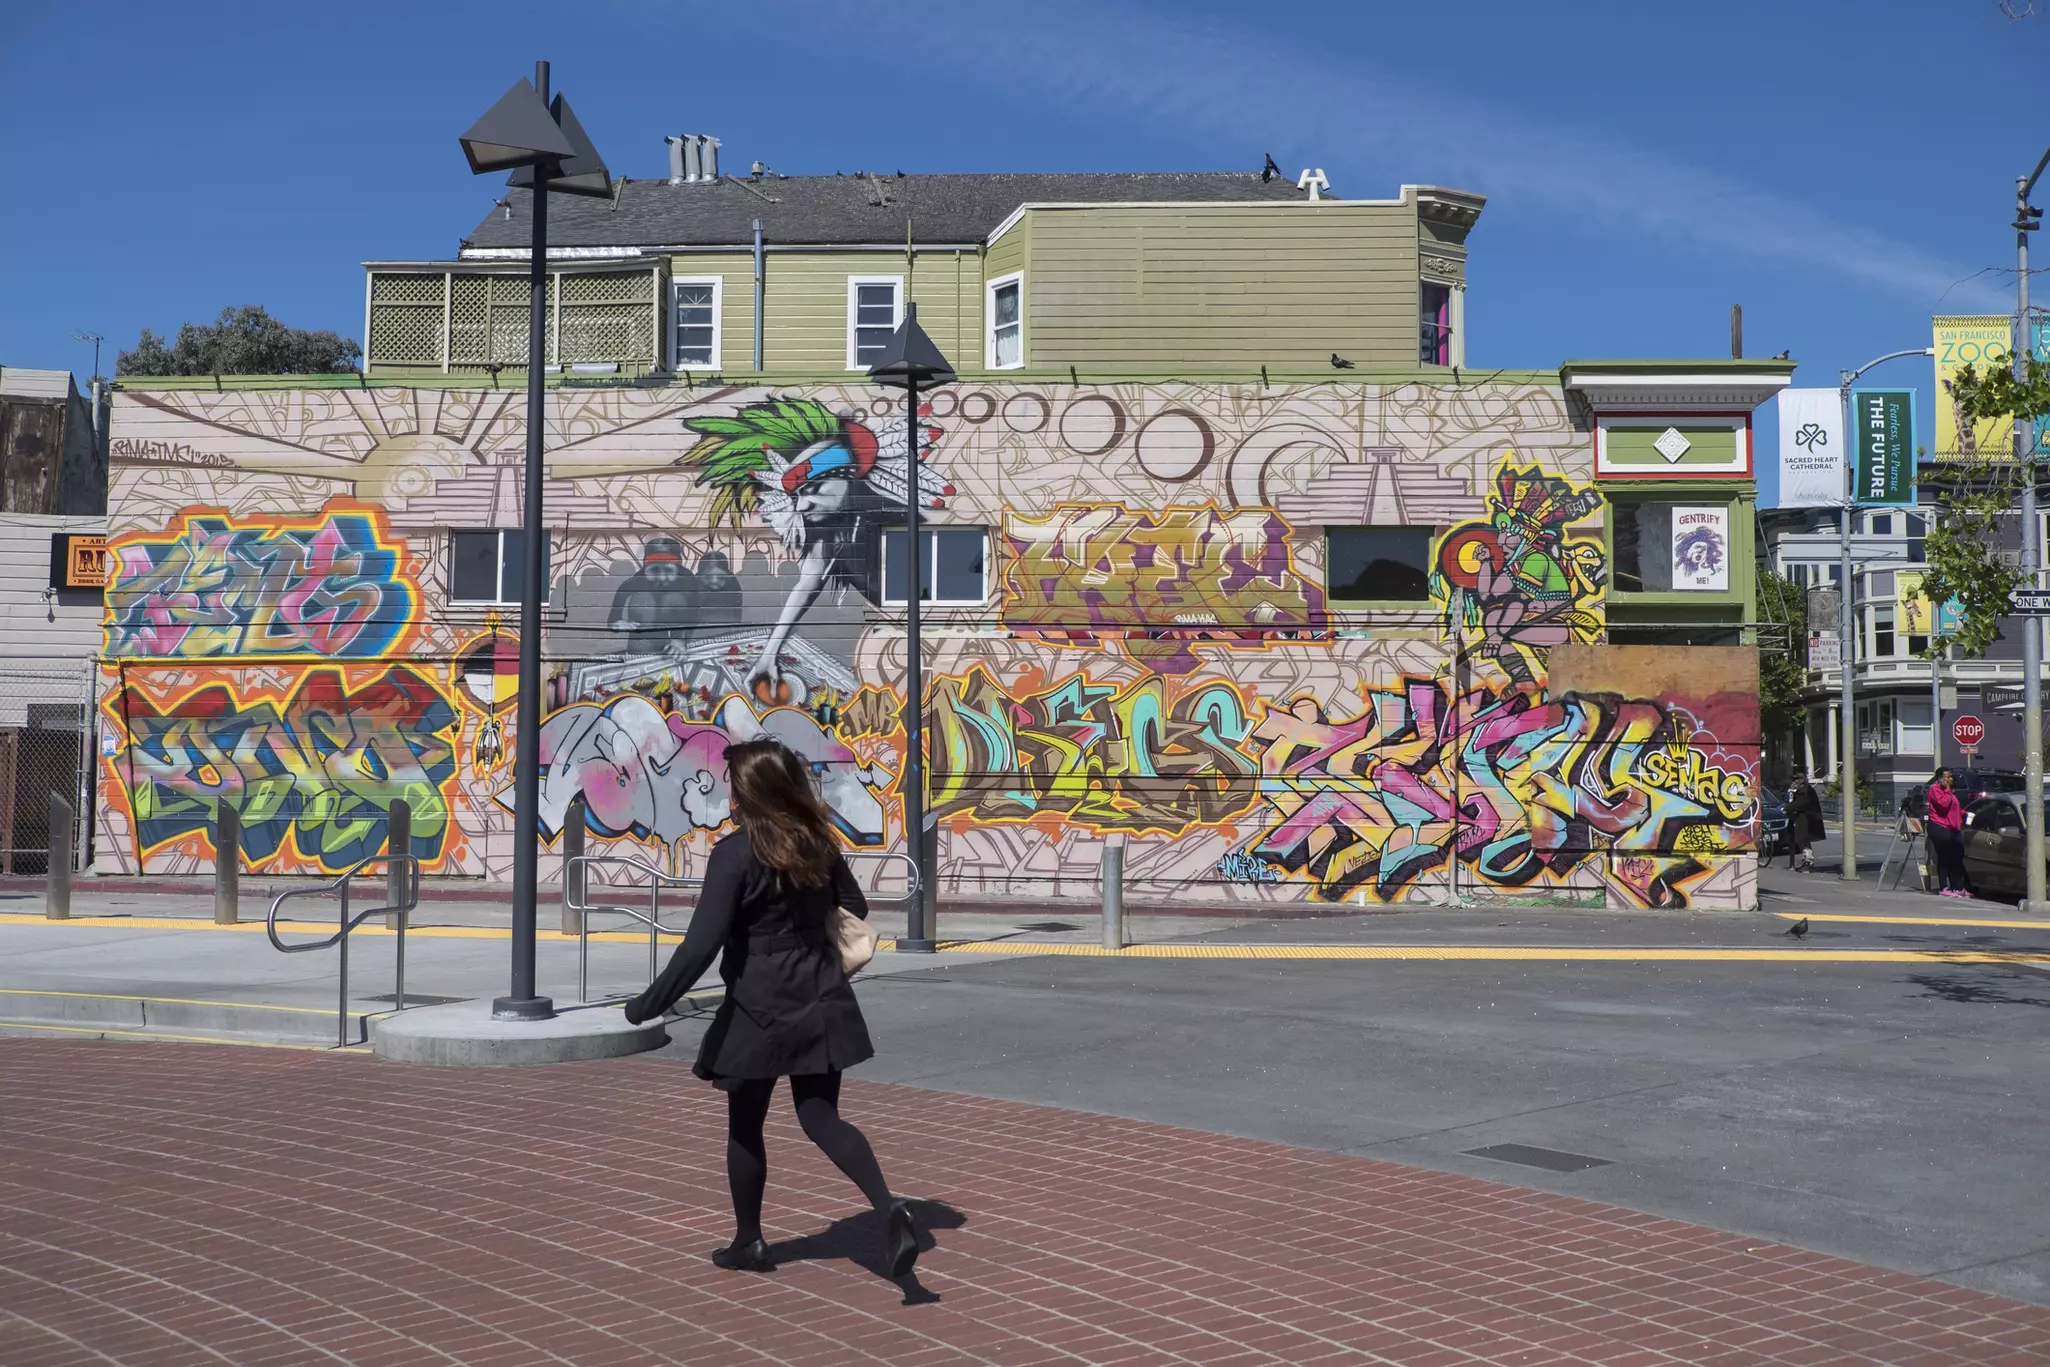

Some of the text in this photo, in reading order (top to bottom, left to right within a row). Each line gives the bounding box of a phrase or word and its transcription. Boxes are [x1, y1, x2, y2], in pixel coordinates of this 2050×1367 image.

[1940, 331, 2006, 340] SAN FRANCISCO
[1940, 342, 2007, 363] ZOO
[1869, 397, 1886, 498] THE FUTURE
[1889, 403, 1901, 492] Fearless, We Pursue
[1679, 513, 1721, 525] GENTRIFY
[1696, 576, 1710, 585] ME!
[2016, 597, 2039, 608] ONE
[1809, 638, 1819, 647] NO
[1986, 692, 2019, 704] CAMPFIRE
[1955, 725, 1982, 736] STOP
